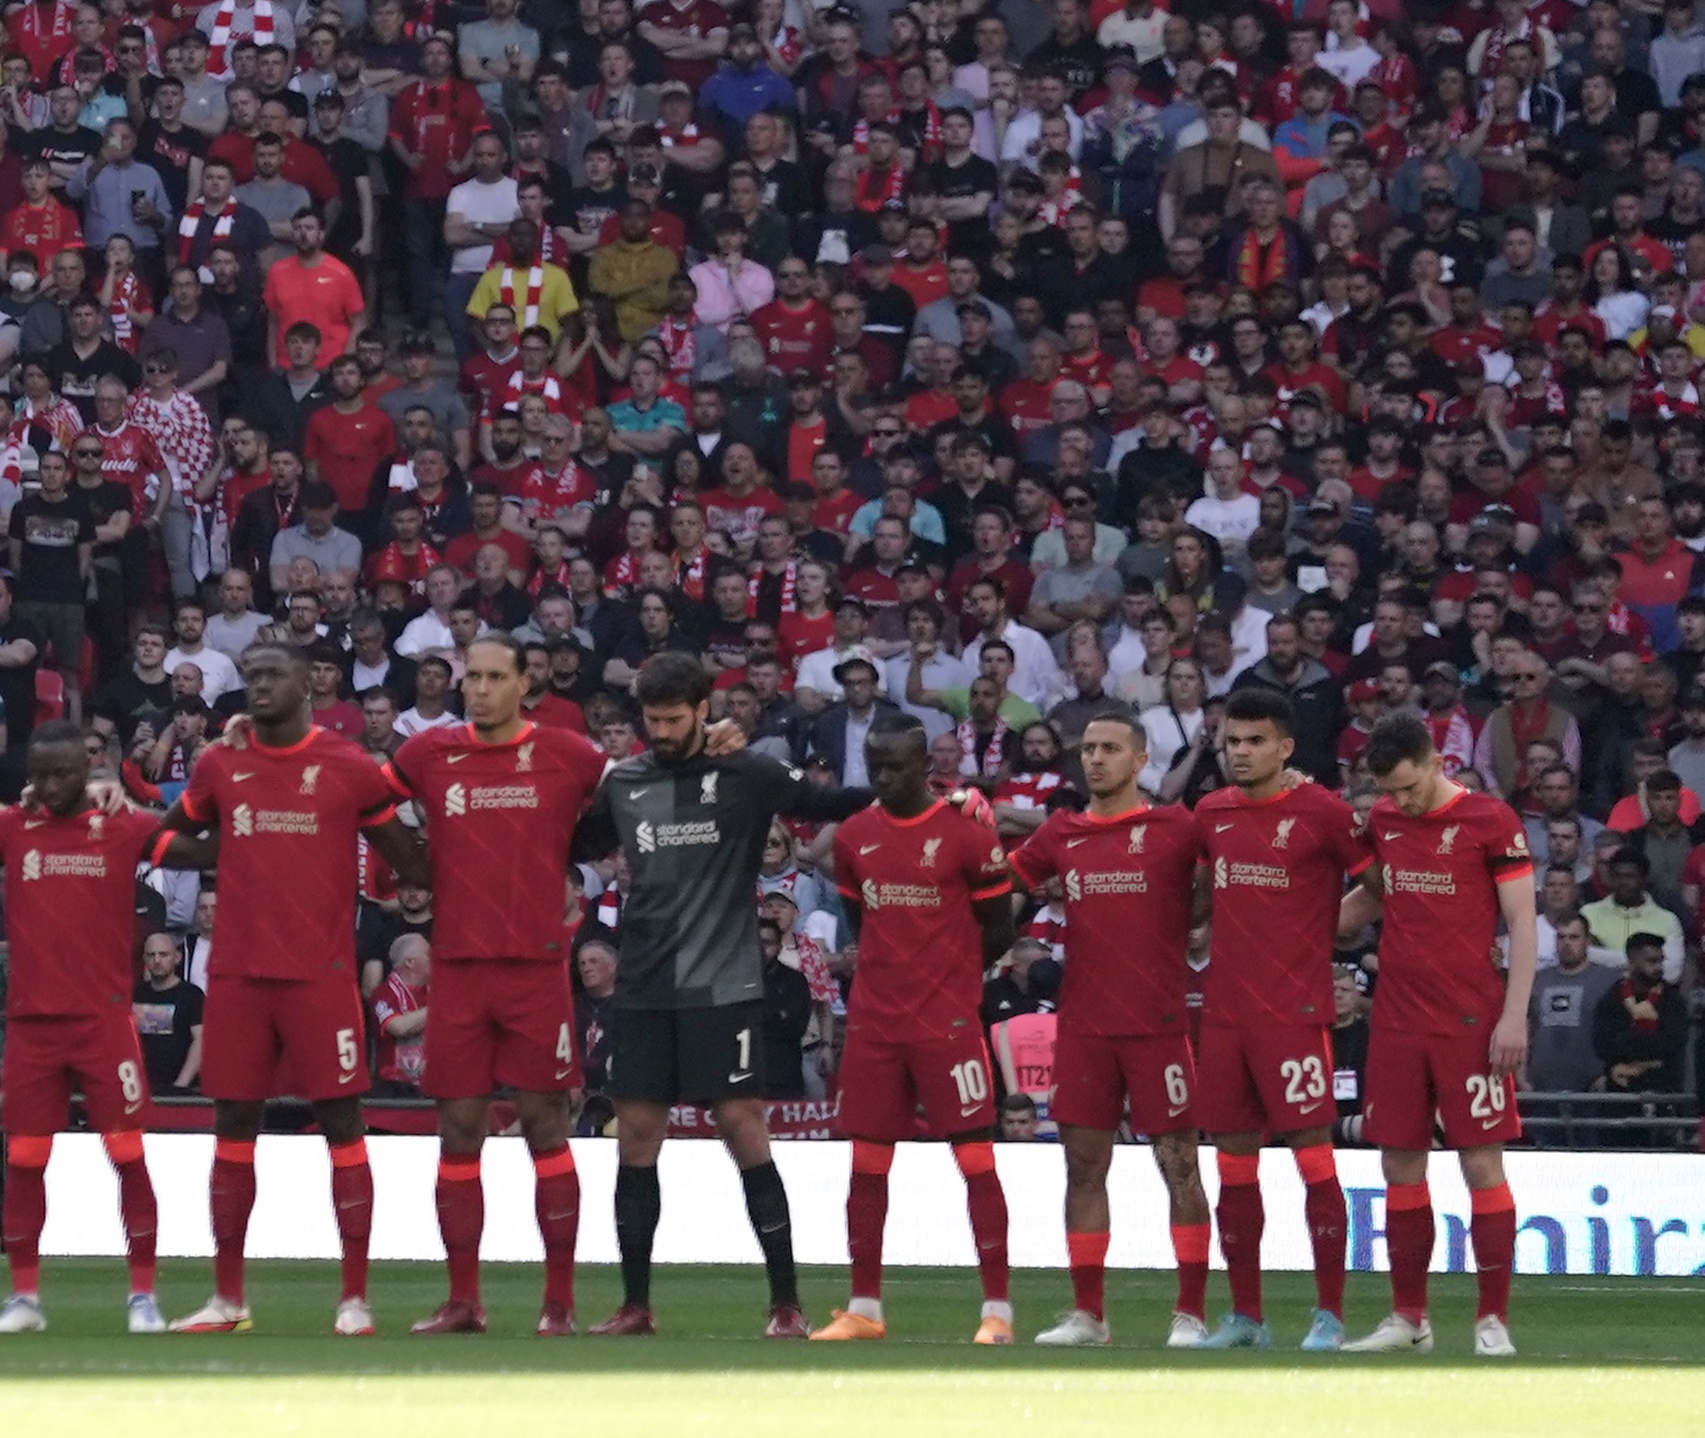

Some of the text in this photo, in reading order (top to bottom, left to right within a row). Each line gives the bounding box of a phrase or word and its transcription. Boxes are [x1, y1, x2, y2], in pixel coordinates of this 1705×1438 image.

[470, 786, 536, 799] standard
[469, 797, 539, 810] chartered
[254, 810, 318, 823] standard
[254, 821, 319, 835] chartered
[656, 821, 716, 836] standard
[657, 832, 720, 847] chartered
[43, 854, 103, 866] standard
[43, 864, 107, 878] chartered
[1083, 870, 1143, 883] standard
[1230, 862, 1287, 877] standard
[1395, 870, 1452, 884] standard
[1083, 881, 1148, 894] chartered
[1229, 873, 1290, 888] chartered
[879, 884, 938, 897] standard
[1395, 881, 1456, 896] chartered
[879, 895, 941, 908] chartered
[336, 1028, 358, 1071] 5
[556, 1021, 572, 1064] 4
[736, 1028, 751, 1069] 1
[118, 1061, 141, 1103] 8
[950, 1059, 987, 1105] 10
[1163, 1063, 1188, 1105] 6
[1281, 1056, 1326, 1103] 23
[1466, 1075, 1506, 1119] 26
[1343, 1184, 1705, 1276] Emir
